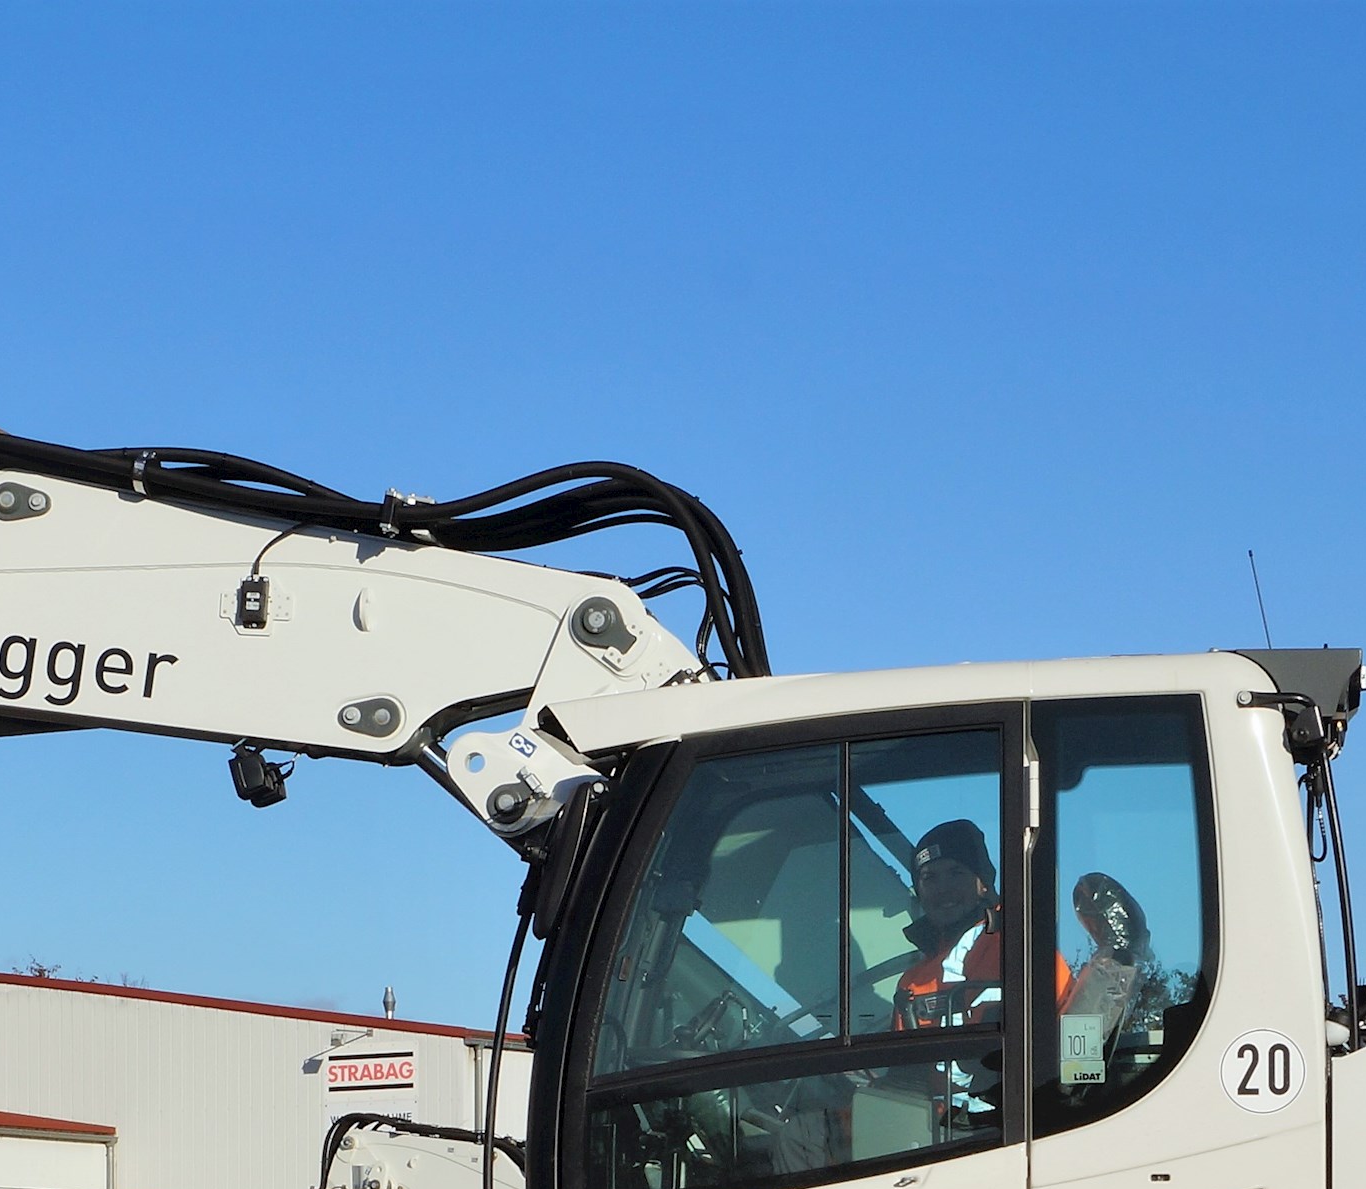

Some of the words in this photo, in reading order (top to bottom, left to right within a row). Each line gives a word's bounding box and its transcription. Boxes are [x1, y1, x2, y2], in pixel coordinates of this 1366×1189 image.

[1068, 1035, 1086, 1056] 101
[328, 1061, 414, 1083] STRABAG
[1237, 1043, 1290, 1095] 20
